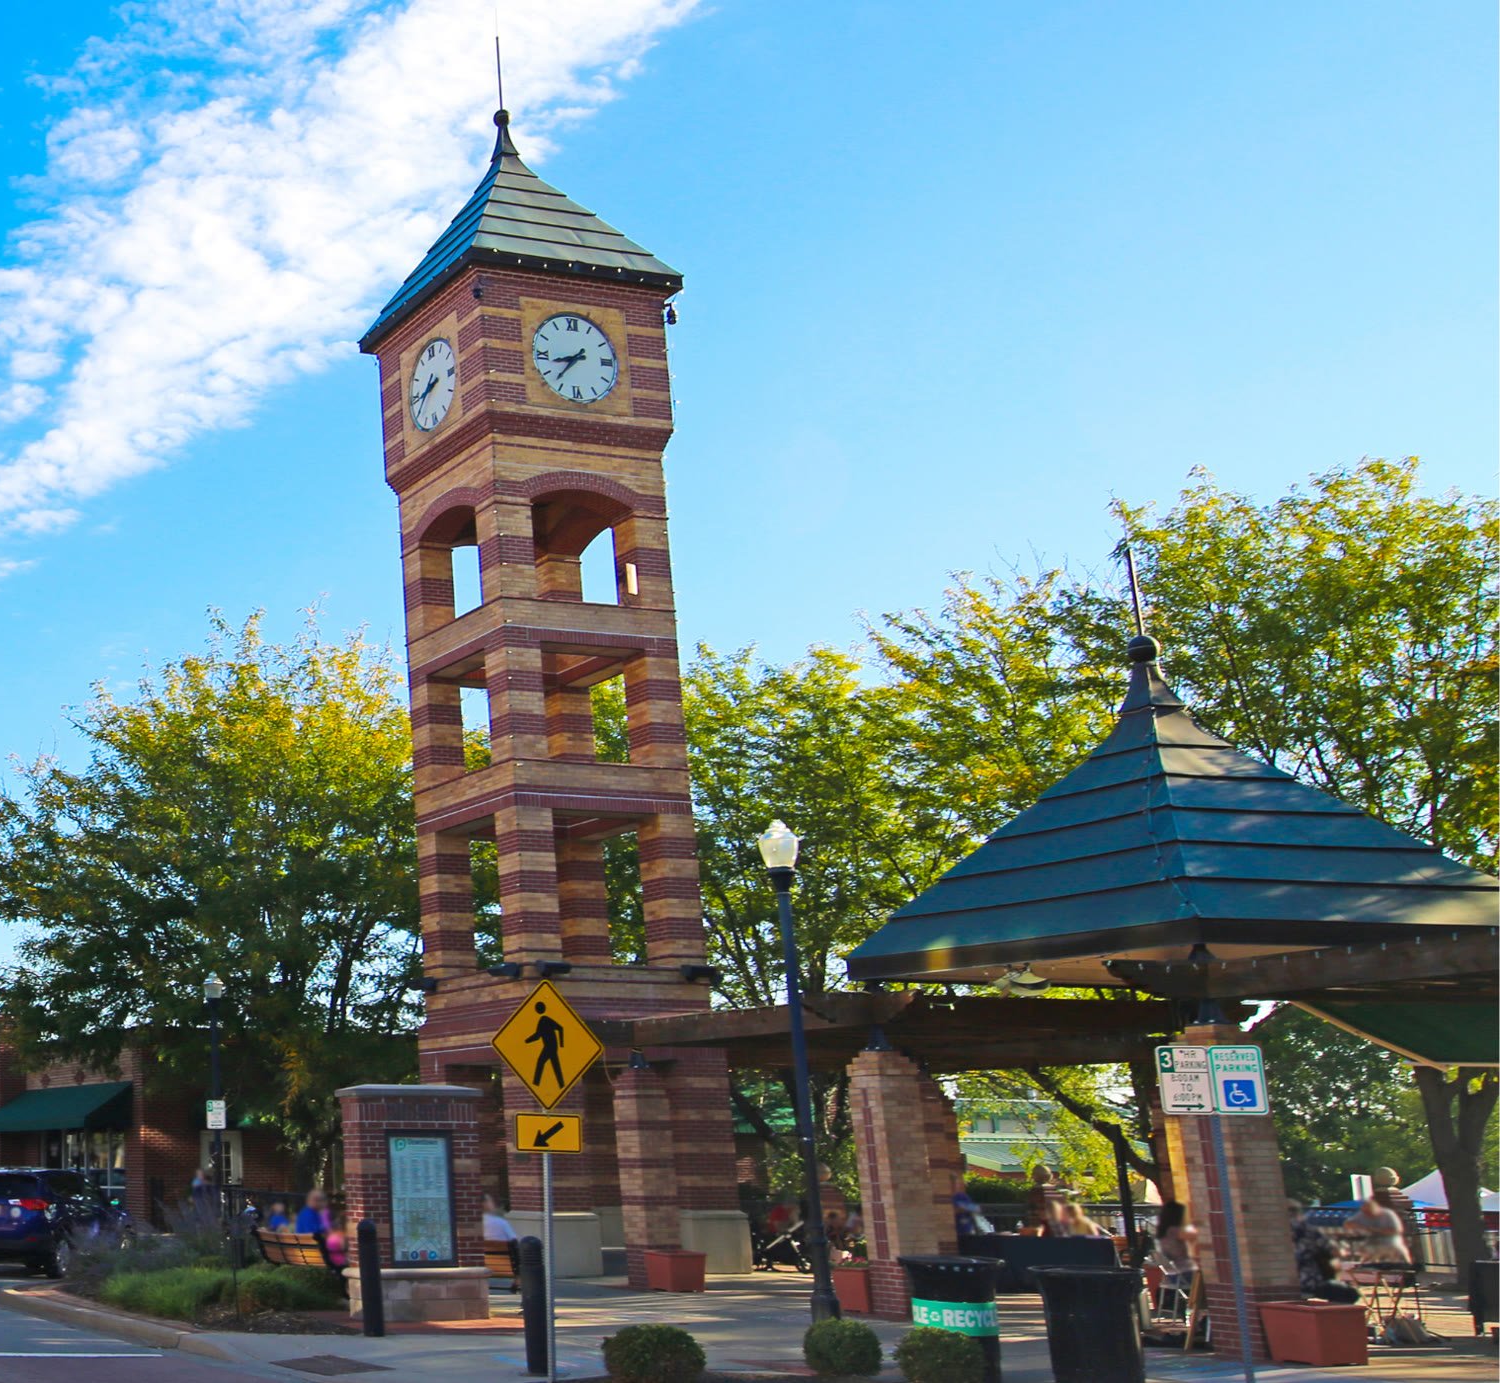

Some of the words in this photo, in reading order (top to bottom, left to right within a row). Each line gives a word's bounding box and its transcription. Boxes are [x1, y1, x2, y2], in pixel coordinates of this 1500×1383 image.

[1160, 1051, 1173, 1068] 3
[1214, 1052, 1256, 1062] RESERVED
[1174, 1061, 1208, 1070] PARKING
[1215, 1064, 1258, 1072] PARKING
[1181, 1083, 1193, 1092] TO
[942, 1309, 997, 1328] RECYCL
